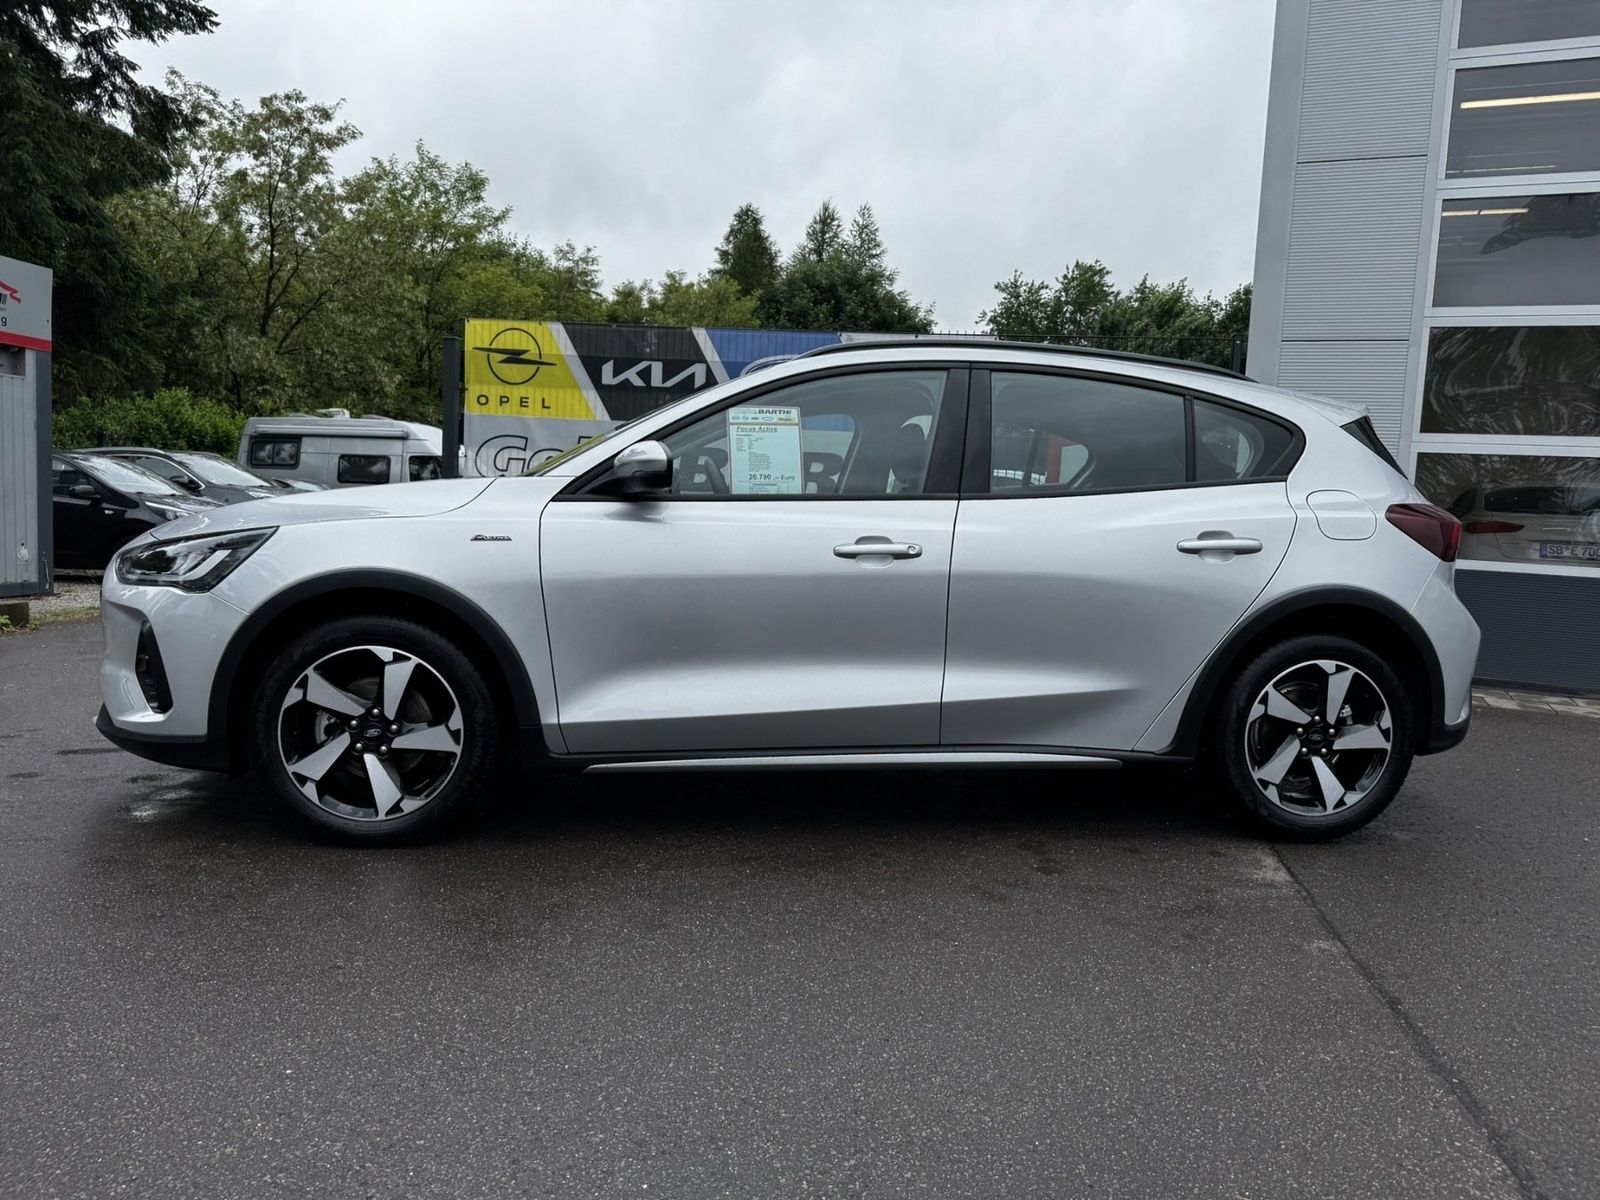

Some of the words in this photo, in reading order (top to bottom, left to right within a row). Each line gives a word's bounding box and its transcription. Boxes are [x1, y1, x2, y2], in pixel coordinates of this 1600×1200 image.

[602, 359, 706, 389] KIA
[476, 394, 551, 409] OPEL
[1548, 545, 1563, 555] SB
